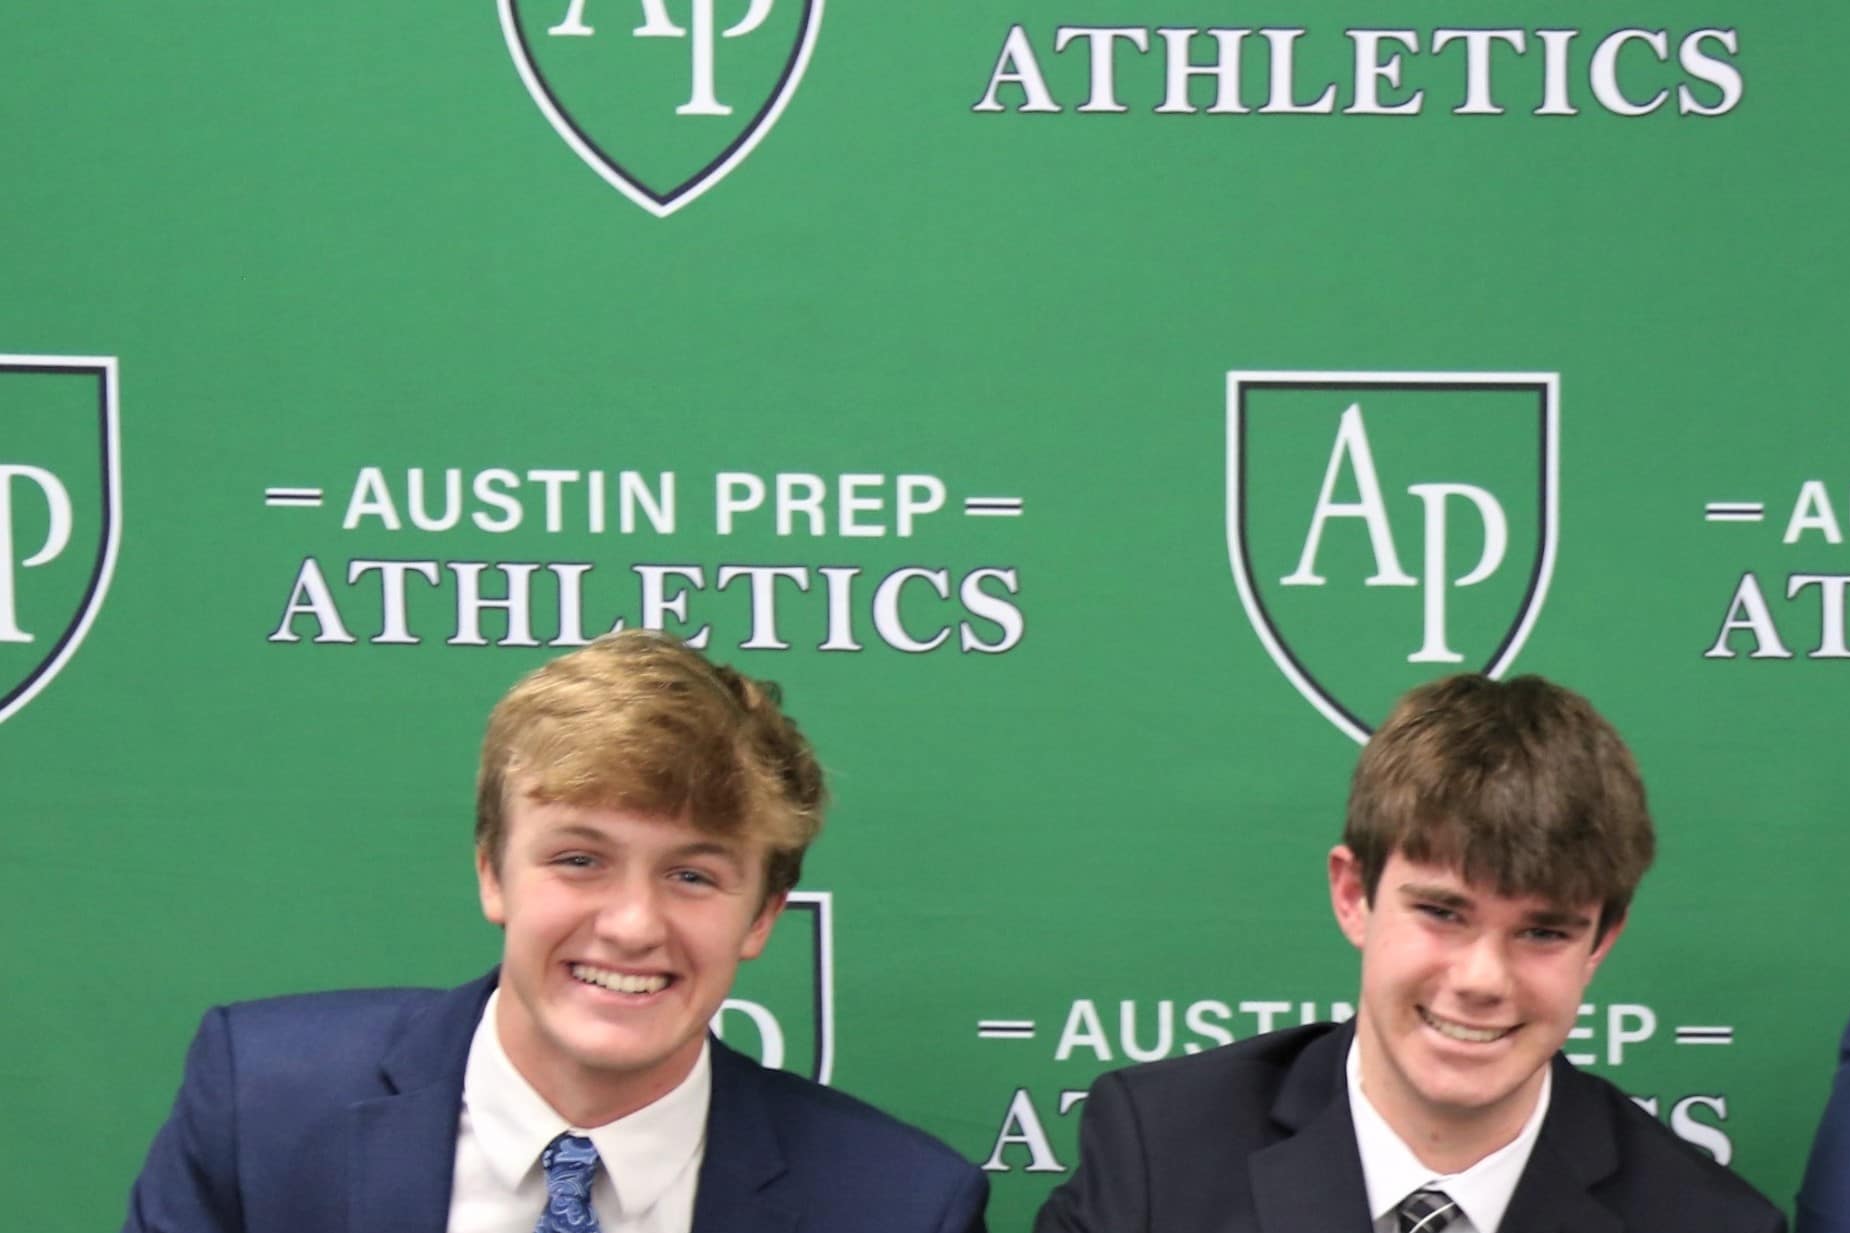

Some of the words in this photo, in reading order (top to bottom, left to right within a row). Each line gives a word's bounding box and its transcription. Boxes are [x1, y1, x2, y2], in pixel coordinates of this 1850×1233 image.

[973, 26, 1743, 116] ATHLETICS
[343, 467, 677, 534] AUSTIN
[715, 472, 948, 537] PREP
[1280, 402, 1509, 663] AP
[268, 556, 1024, 654] ATHLETICS
